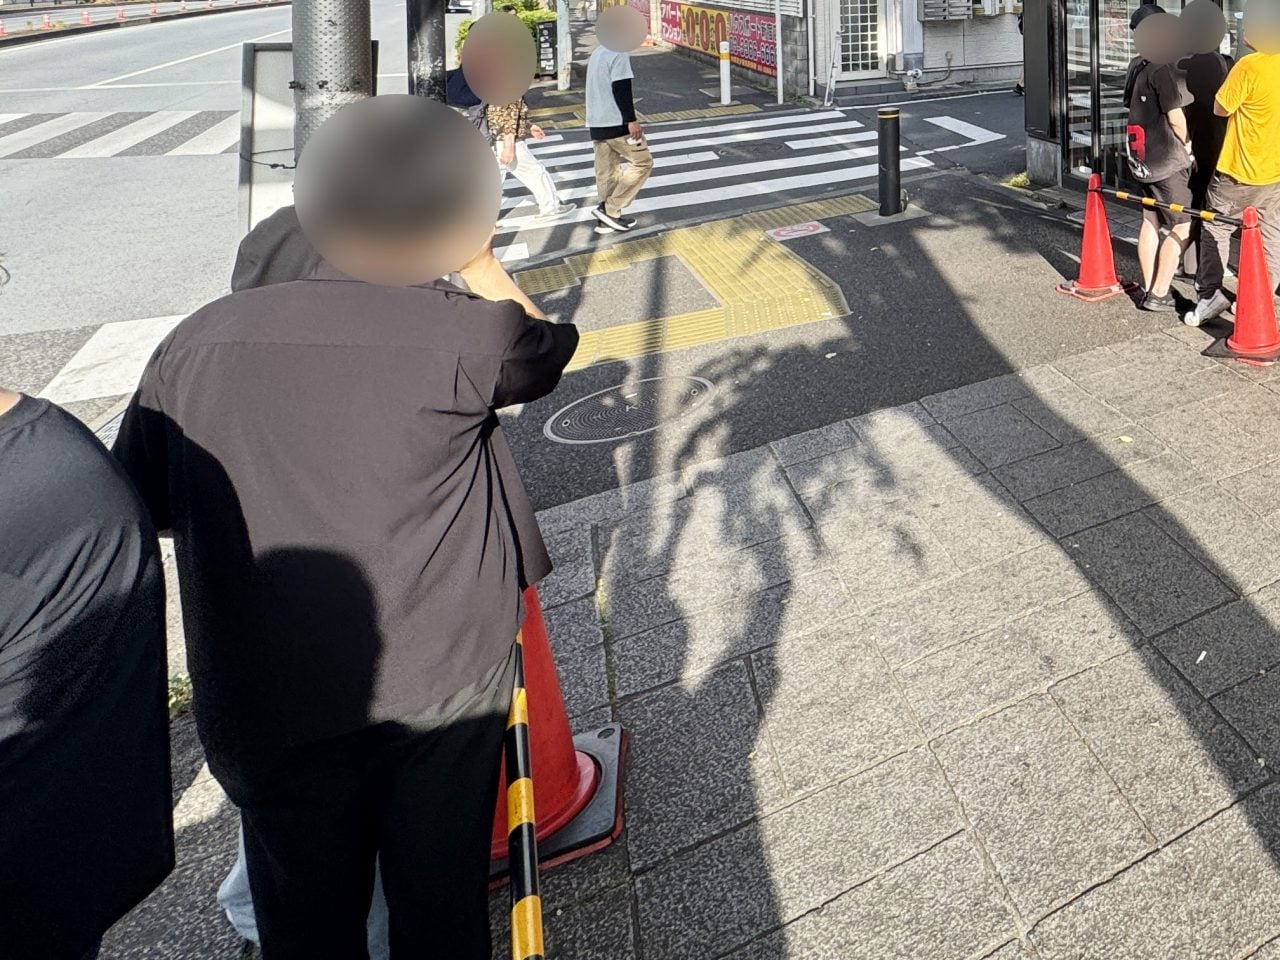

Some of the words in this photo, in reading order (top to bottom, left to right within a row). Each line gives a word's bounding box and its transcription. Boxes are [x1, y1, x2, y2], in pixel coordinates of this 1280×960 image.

[661, 3, 681, 22] アパート
[662, 22, 682, 42] マンション
